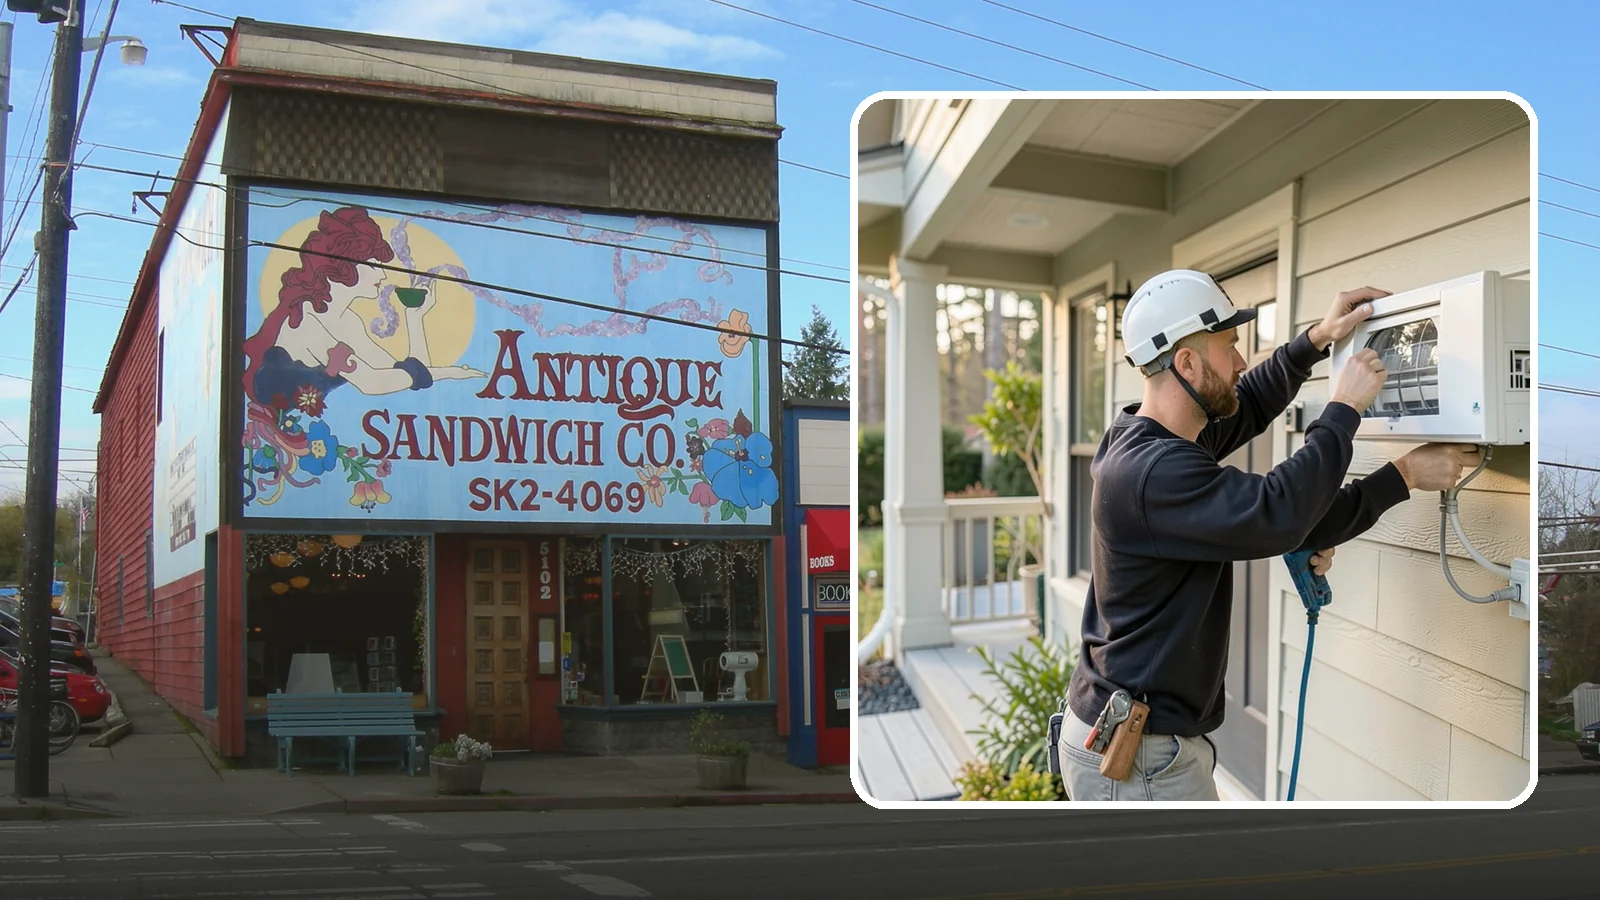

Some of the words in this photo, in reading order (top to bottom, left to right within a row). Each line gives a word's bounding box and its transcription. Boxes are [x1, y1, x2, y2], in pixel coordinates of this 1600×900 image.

[476, 329, 724, 420] ANTIQUE
[361, 408, 604, 467] SANDWICH
[616, 422, 685, 469] CO.
[468, 477, 646, 513] SK2-4069
[539, 541, 551, 600] 5102
[809, 554, 835, 569] BOOKS
